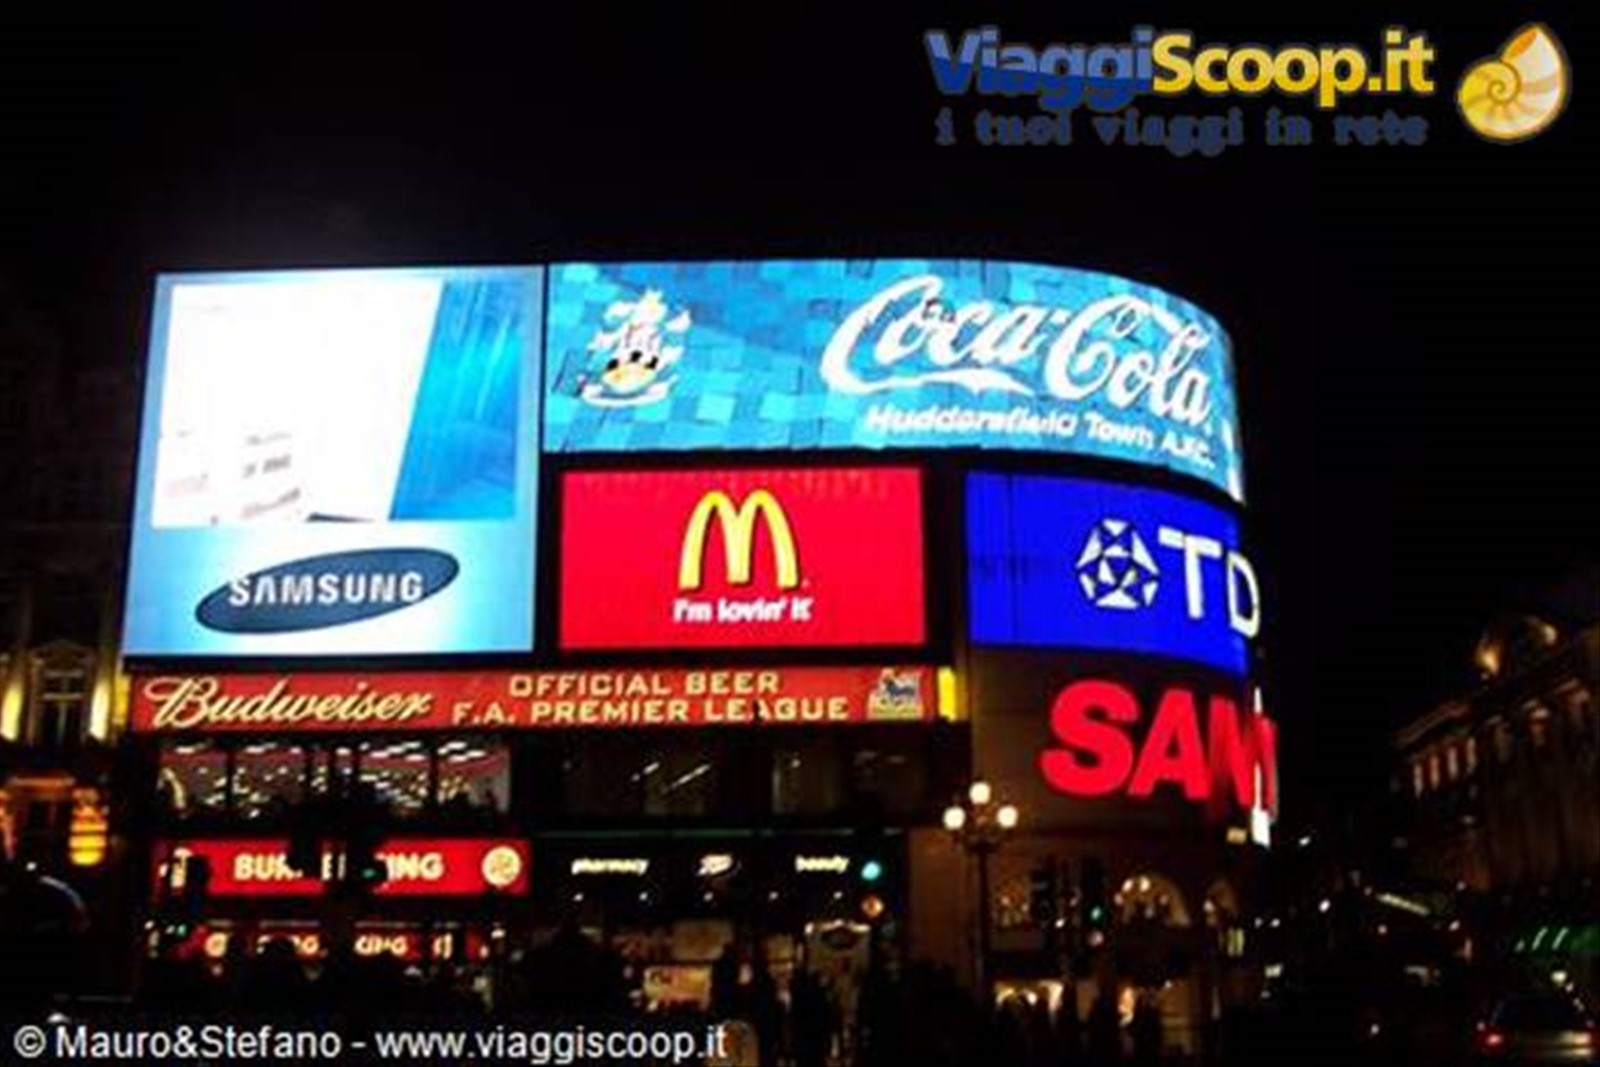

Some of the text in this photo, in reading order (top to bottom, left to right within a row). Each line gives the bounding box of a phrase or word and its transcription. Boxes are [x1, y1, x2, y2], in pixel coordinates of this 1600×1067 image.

[820, 274, 1213, 426] Coca-Cola
[1084, 411, 1155, 451] Town
[228, 572, 424, 606] SAMSUNG
[510, 671, 780, 698] OFFICIAL BEER
[145, 675, 434, 729] Budweiser
[452, 702, 517, 725] F.A.
[531, 699, 689, 724] PREMIER
[377, 852, 445, 881] ING
